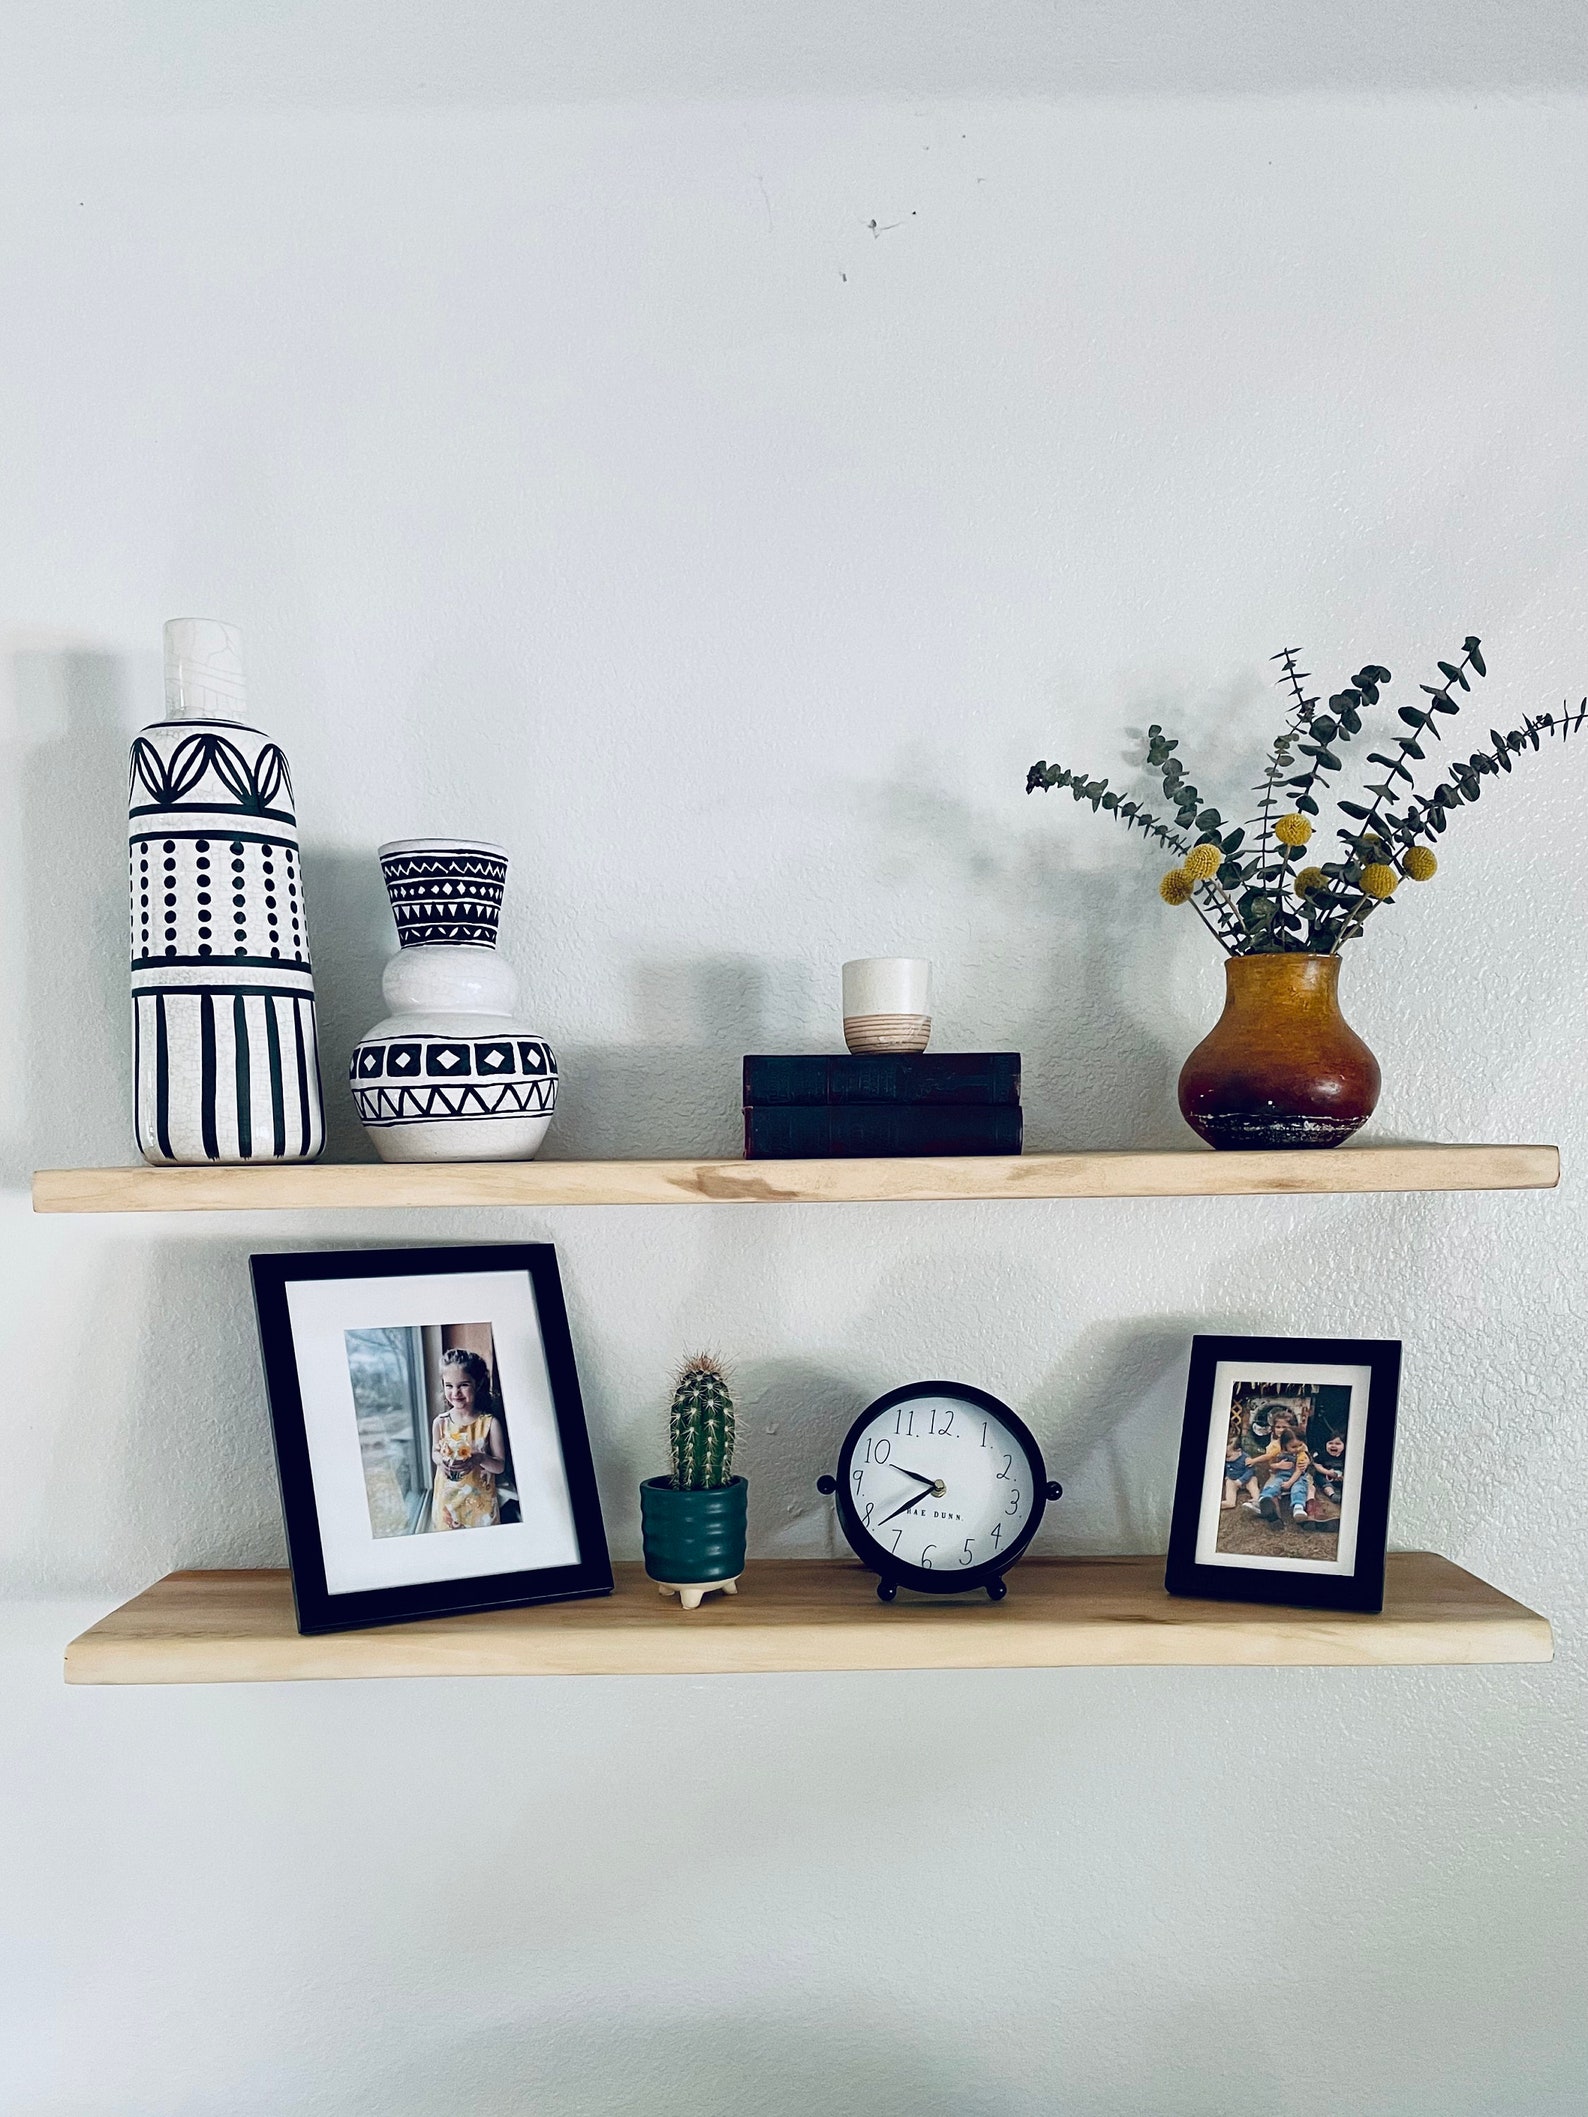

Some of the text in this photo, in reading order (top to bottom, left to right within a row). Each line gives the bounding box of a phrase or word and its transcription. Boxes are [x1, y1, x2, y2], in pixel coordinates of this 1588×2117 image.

[894, 1409, 919, 1438] 11.
[928, 1409, 960, 1438] 12.
[980, 1421, 993, 1449] 1.
[864, 1437, 891, 1465] 10
[996, 1454, 1017, 1482] 2.
[852, 1469, 865, 1497] 9.
[1004, 1488, 1022, 1519] 3.
[892, 1528, 903, 1554] 7
[921, 1544, 937, 1569] 6
